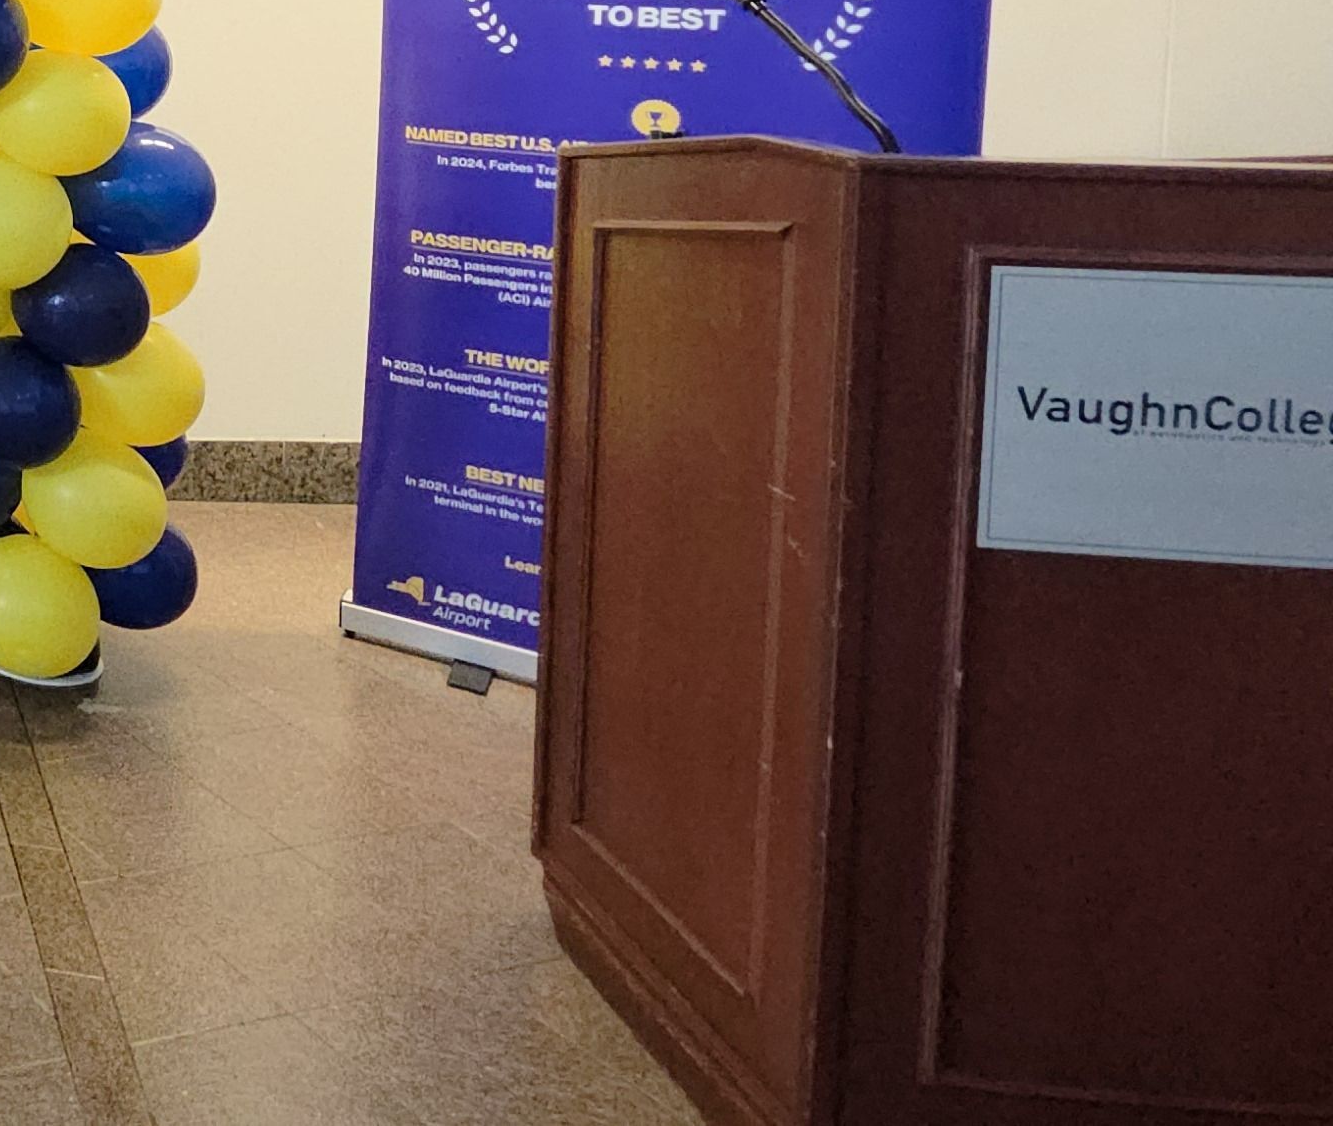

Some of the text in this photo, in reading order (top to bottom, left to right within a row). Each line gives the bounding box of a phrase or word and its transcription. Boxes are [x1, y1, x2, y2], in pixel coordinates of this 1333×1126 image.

[588, 4, 726, 31] TO BEST
[405, 126, 468, 145] NAMED
[470, 133, 519, 148] BEST
[521, 137, 556, 152] U.S.
[437, 155, 557, 175] In 2024, Forbes Tra
[536, 178, 557, 189] bes
[410, 229, 555, 260] PASSENGER-RA
[403, 266, 419, 276] 40
[422, 267, 461, 282] Million
[464, 274, 538, 292] Passengers
[414, 253, 536, 280] In 2023, passengers
[498, 292, 551, 308] (ACI) Air
[464, 349, 503, 368] THE
[382, 356, 547, 394] In 2023, LaGuardia Airport's
[390, 372, 424, 387] based
[426, 380, 442, 391] on
[444, 382, 501, 400] feedback
[504, 392, 534, 406] from
[1017, 385, 1333, 445] VaughnColle
[405, 475, 416, 486] In
[418, 479, 450, 494] 2021,
[453, 485, 525, 509] LaGuardia's
[466, 465, 545, 493] BEST NE
[434, 495, 483, 514] terminal
[485, 505, 496, 516] in
[499, 507, 520, 522] the
[433, 606, 491, 630] Airport
